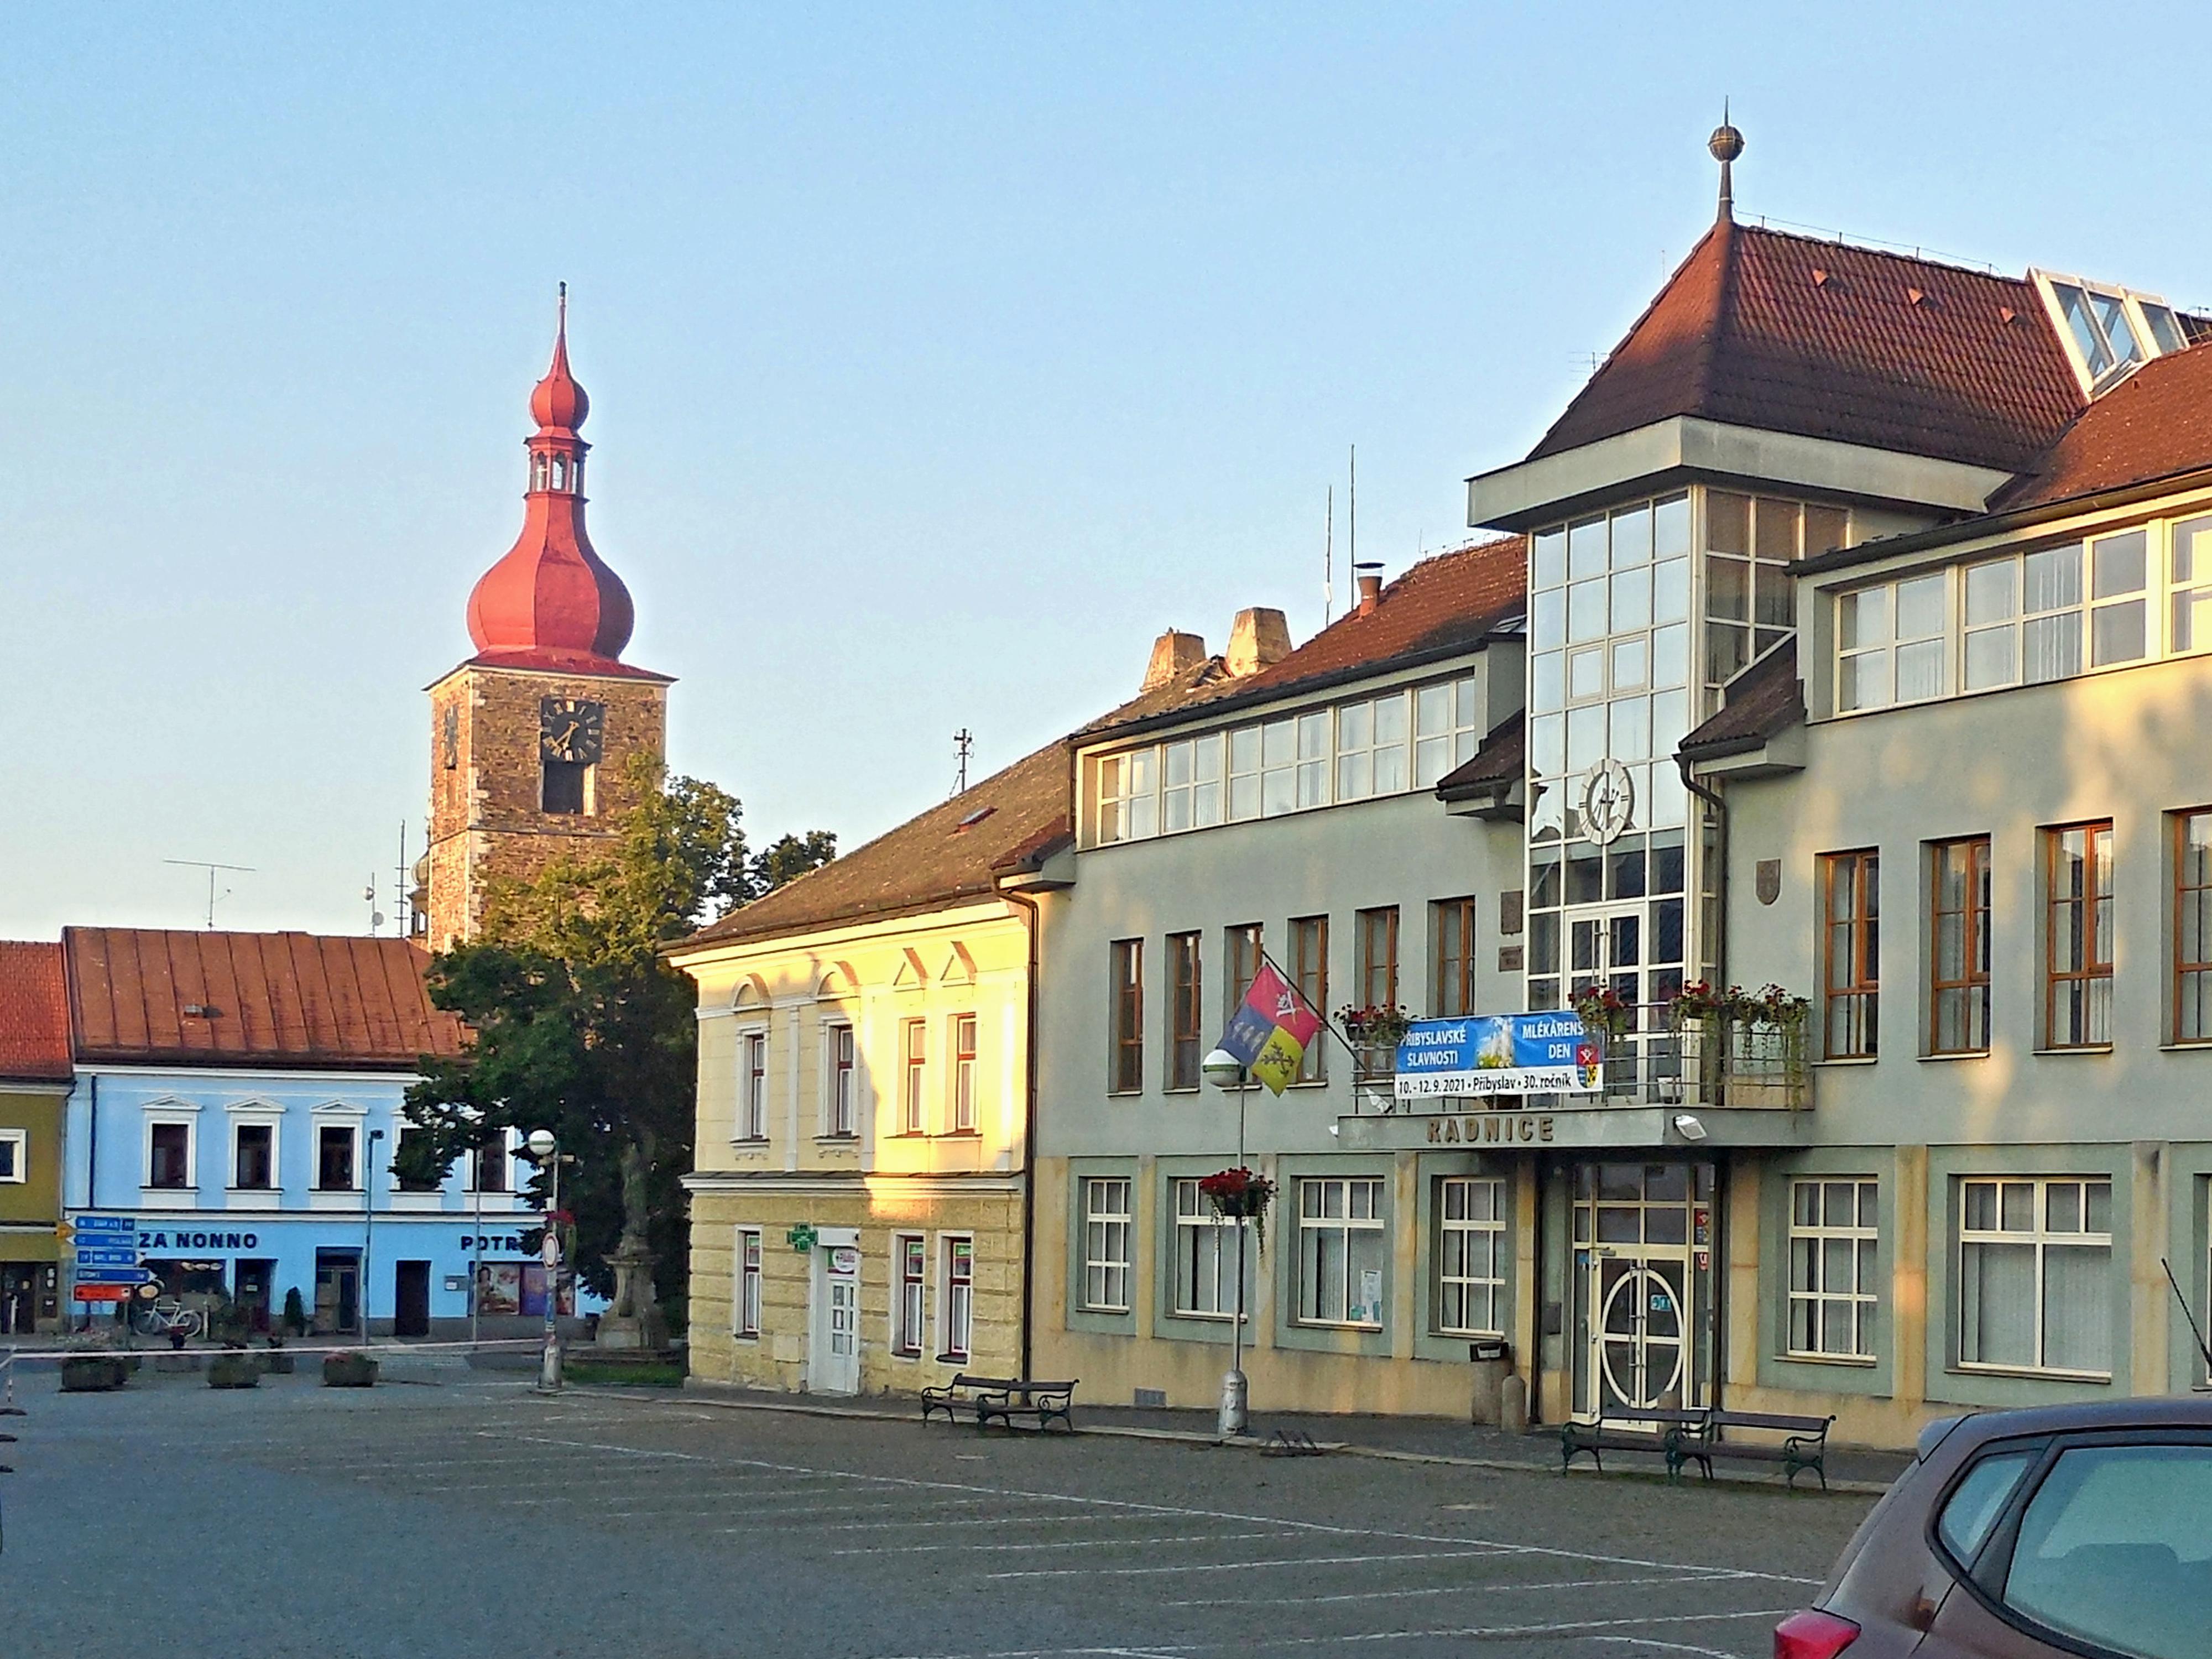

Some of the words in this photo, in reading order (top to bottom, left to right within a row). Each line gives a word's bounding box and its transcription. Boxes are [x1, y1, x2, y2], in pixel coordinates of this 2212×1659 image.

[1407, 1050, 1458, 1067] SLAVNOSTI
[1548, 1044, 1571, 1060] DEN
[1473, 1076, 1516, 1093] Přibyslav
[1524, 1075, 1538, 1089] 30.
[1540, 1073, 1572, 1088] ročník
[1426, 1116, 1554, 1143] RADNICE
[176, 1233, 257, 1249] NONNO
[461, 1235, 519, 1251] POTR
